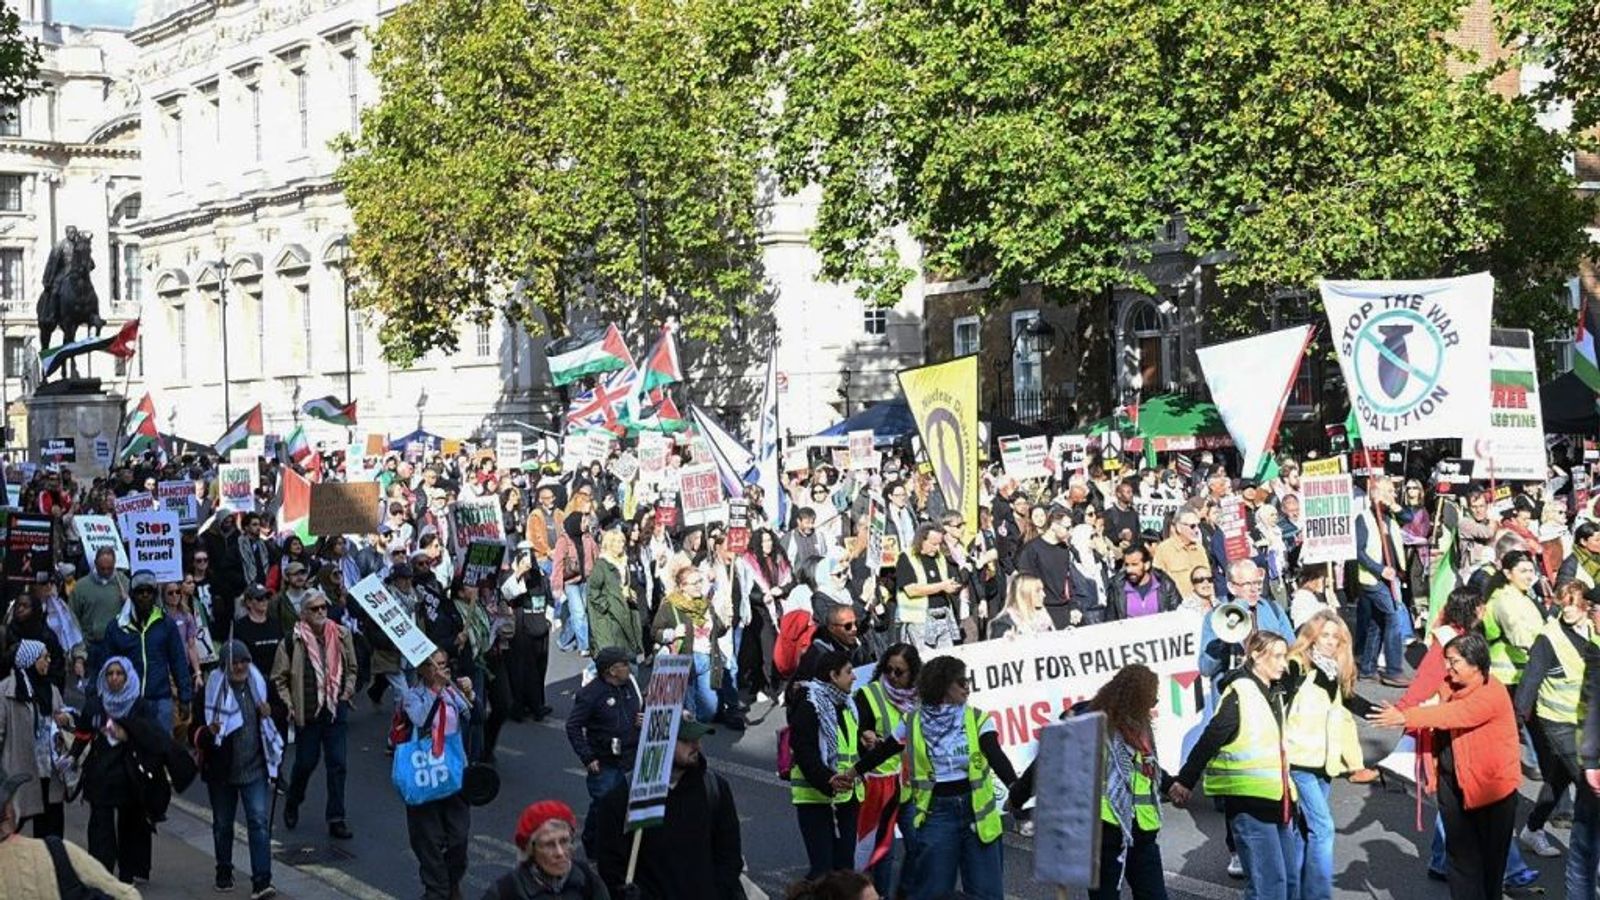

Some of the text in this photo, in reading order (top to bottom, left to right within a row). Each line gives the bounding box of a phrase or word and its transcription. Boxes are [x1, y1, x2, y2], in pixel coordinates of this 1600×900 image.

[1343, 294, 1459, 357] STOP THE WAR
[1491, 388, 1527, 408] REE
[1357, 385, 1449, 432] COALITION
[1490, 412, 1536, 428] LESTINE
[116, 498, 154, 514] SANCTION
[1304, 495, 1350, 517] RIGHT TO
[83, 522, 111, 534] Stop
[136, 521, 171, 535] Stop
[1306, 515, 1350, 538] PROTEST
[86, 534, 117, 545] Arming
[135, 537, 174, 550] Arming
[138, 550, 173, 561] Israel
[986, 660, 1025, 689] DAY
[1034, 656, 1075, 681] FOR
[1079, 632, 1195, 675] PALESTINE
